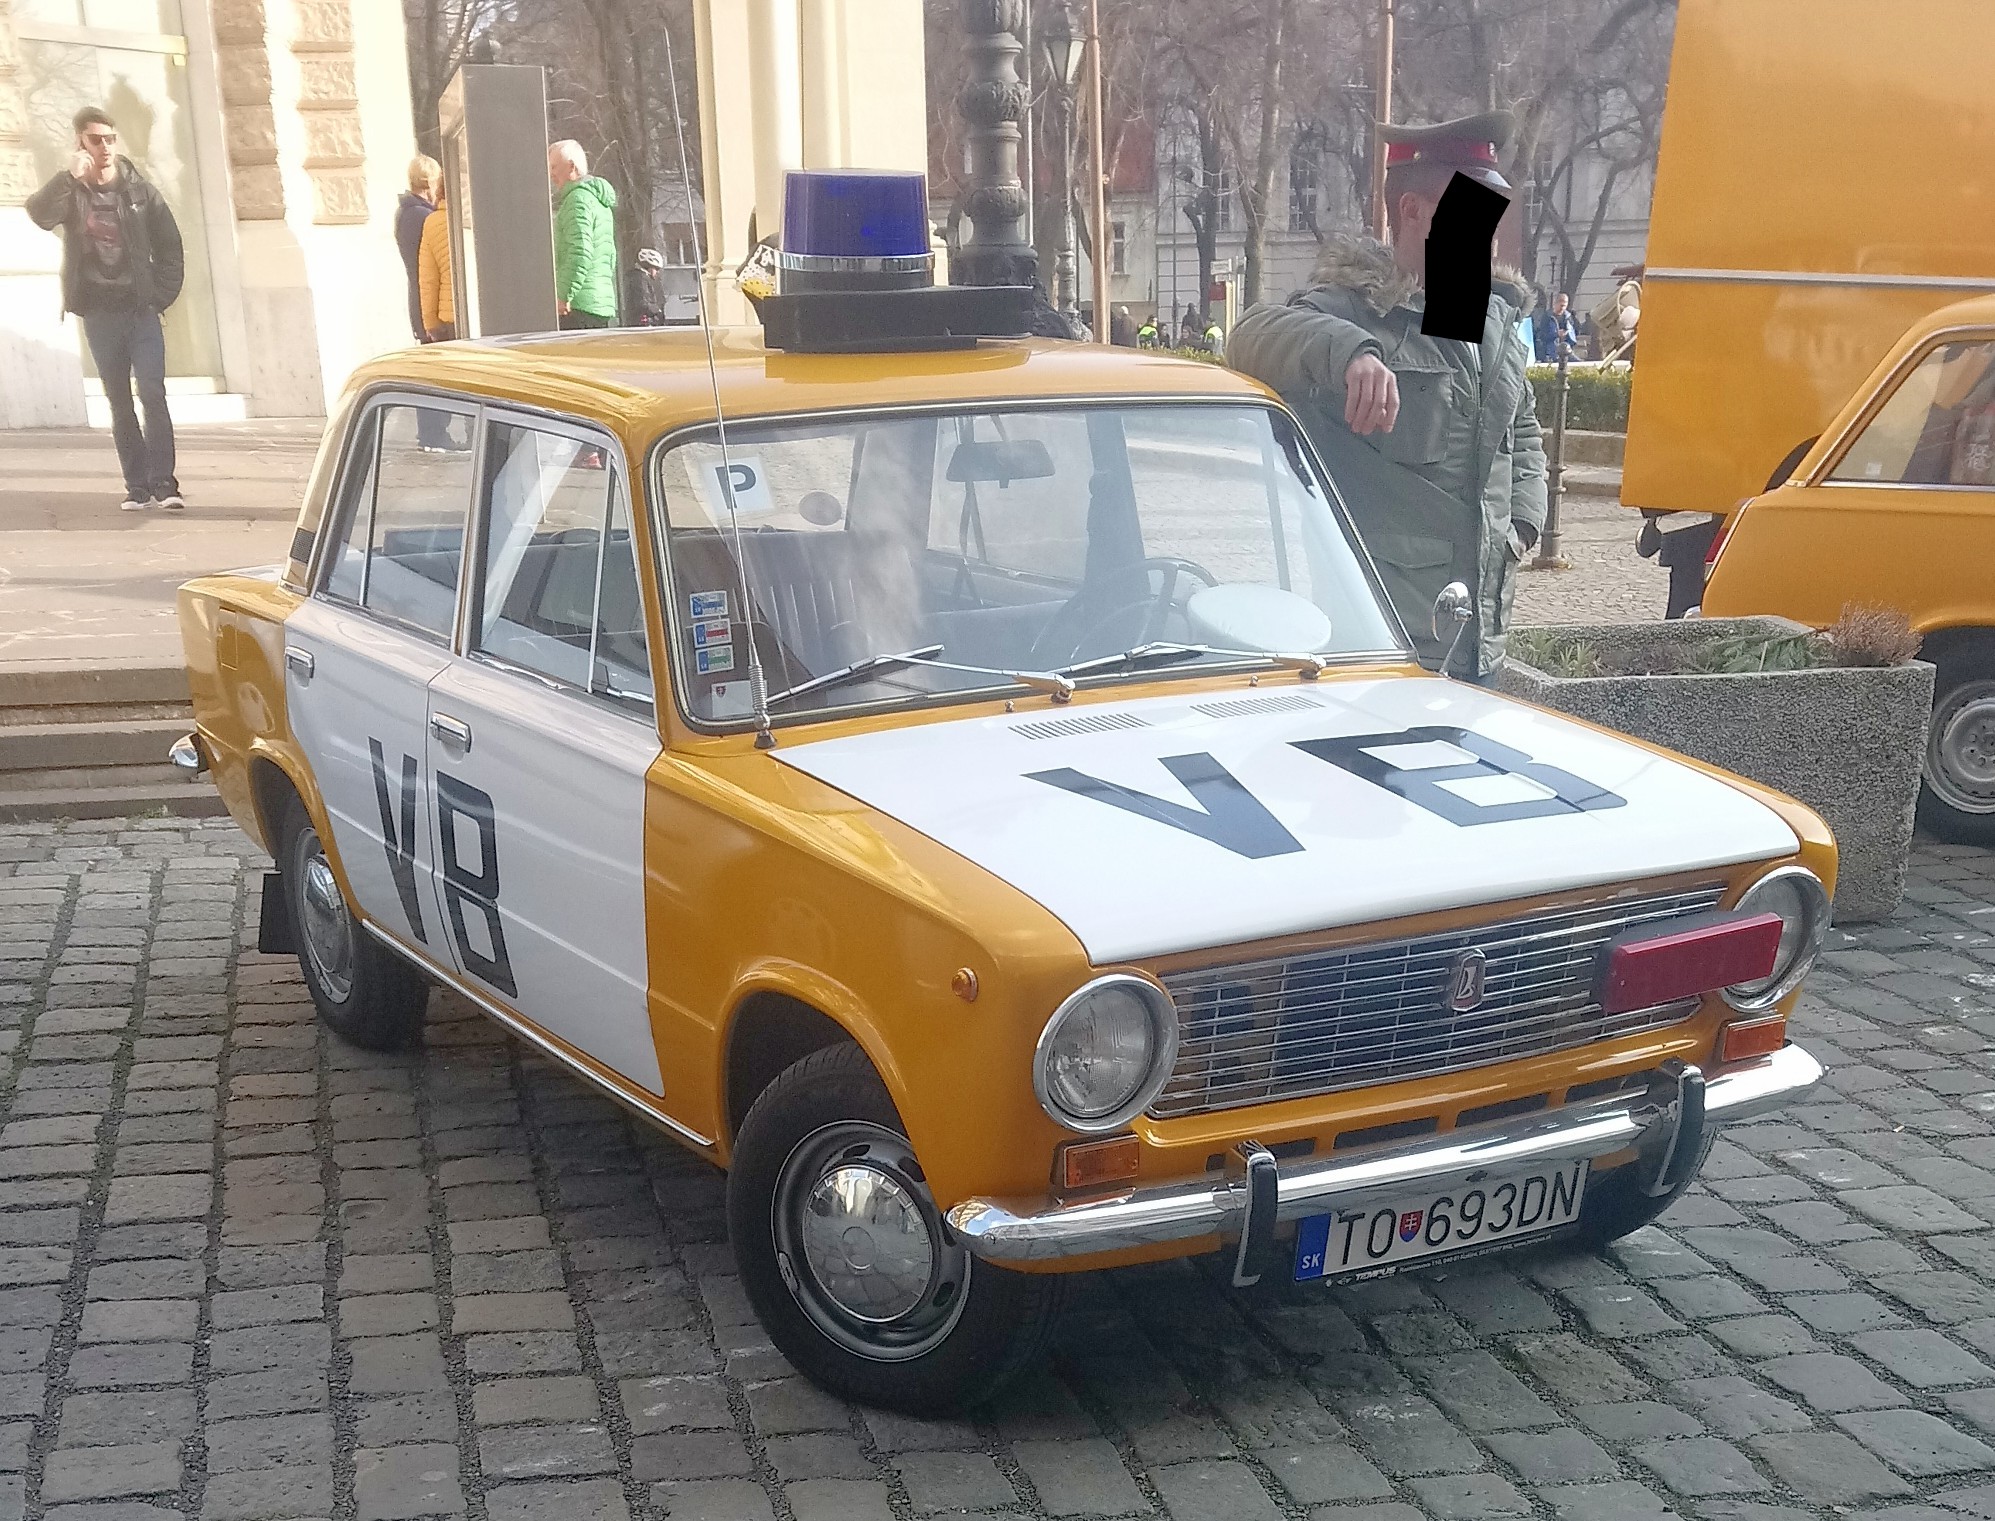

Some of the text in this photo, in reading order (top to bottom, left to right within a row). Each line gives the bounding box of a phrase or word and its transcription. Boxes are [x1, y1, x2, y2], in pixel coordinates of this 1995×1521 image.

[714, 464, 757, 510] P
[1020, 725, 1628, 860] VB
[368, 735, 518, 999] VB
[1336, 1209, 1397, 1266] TO
[1424, 1167, 1582, 1247] 693DN
[1301, 1252, 1321, 1271] SK
[1355, 1265, 1397, 1282] TEMPUS
